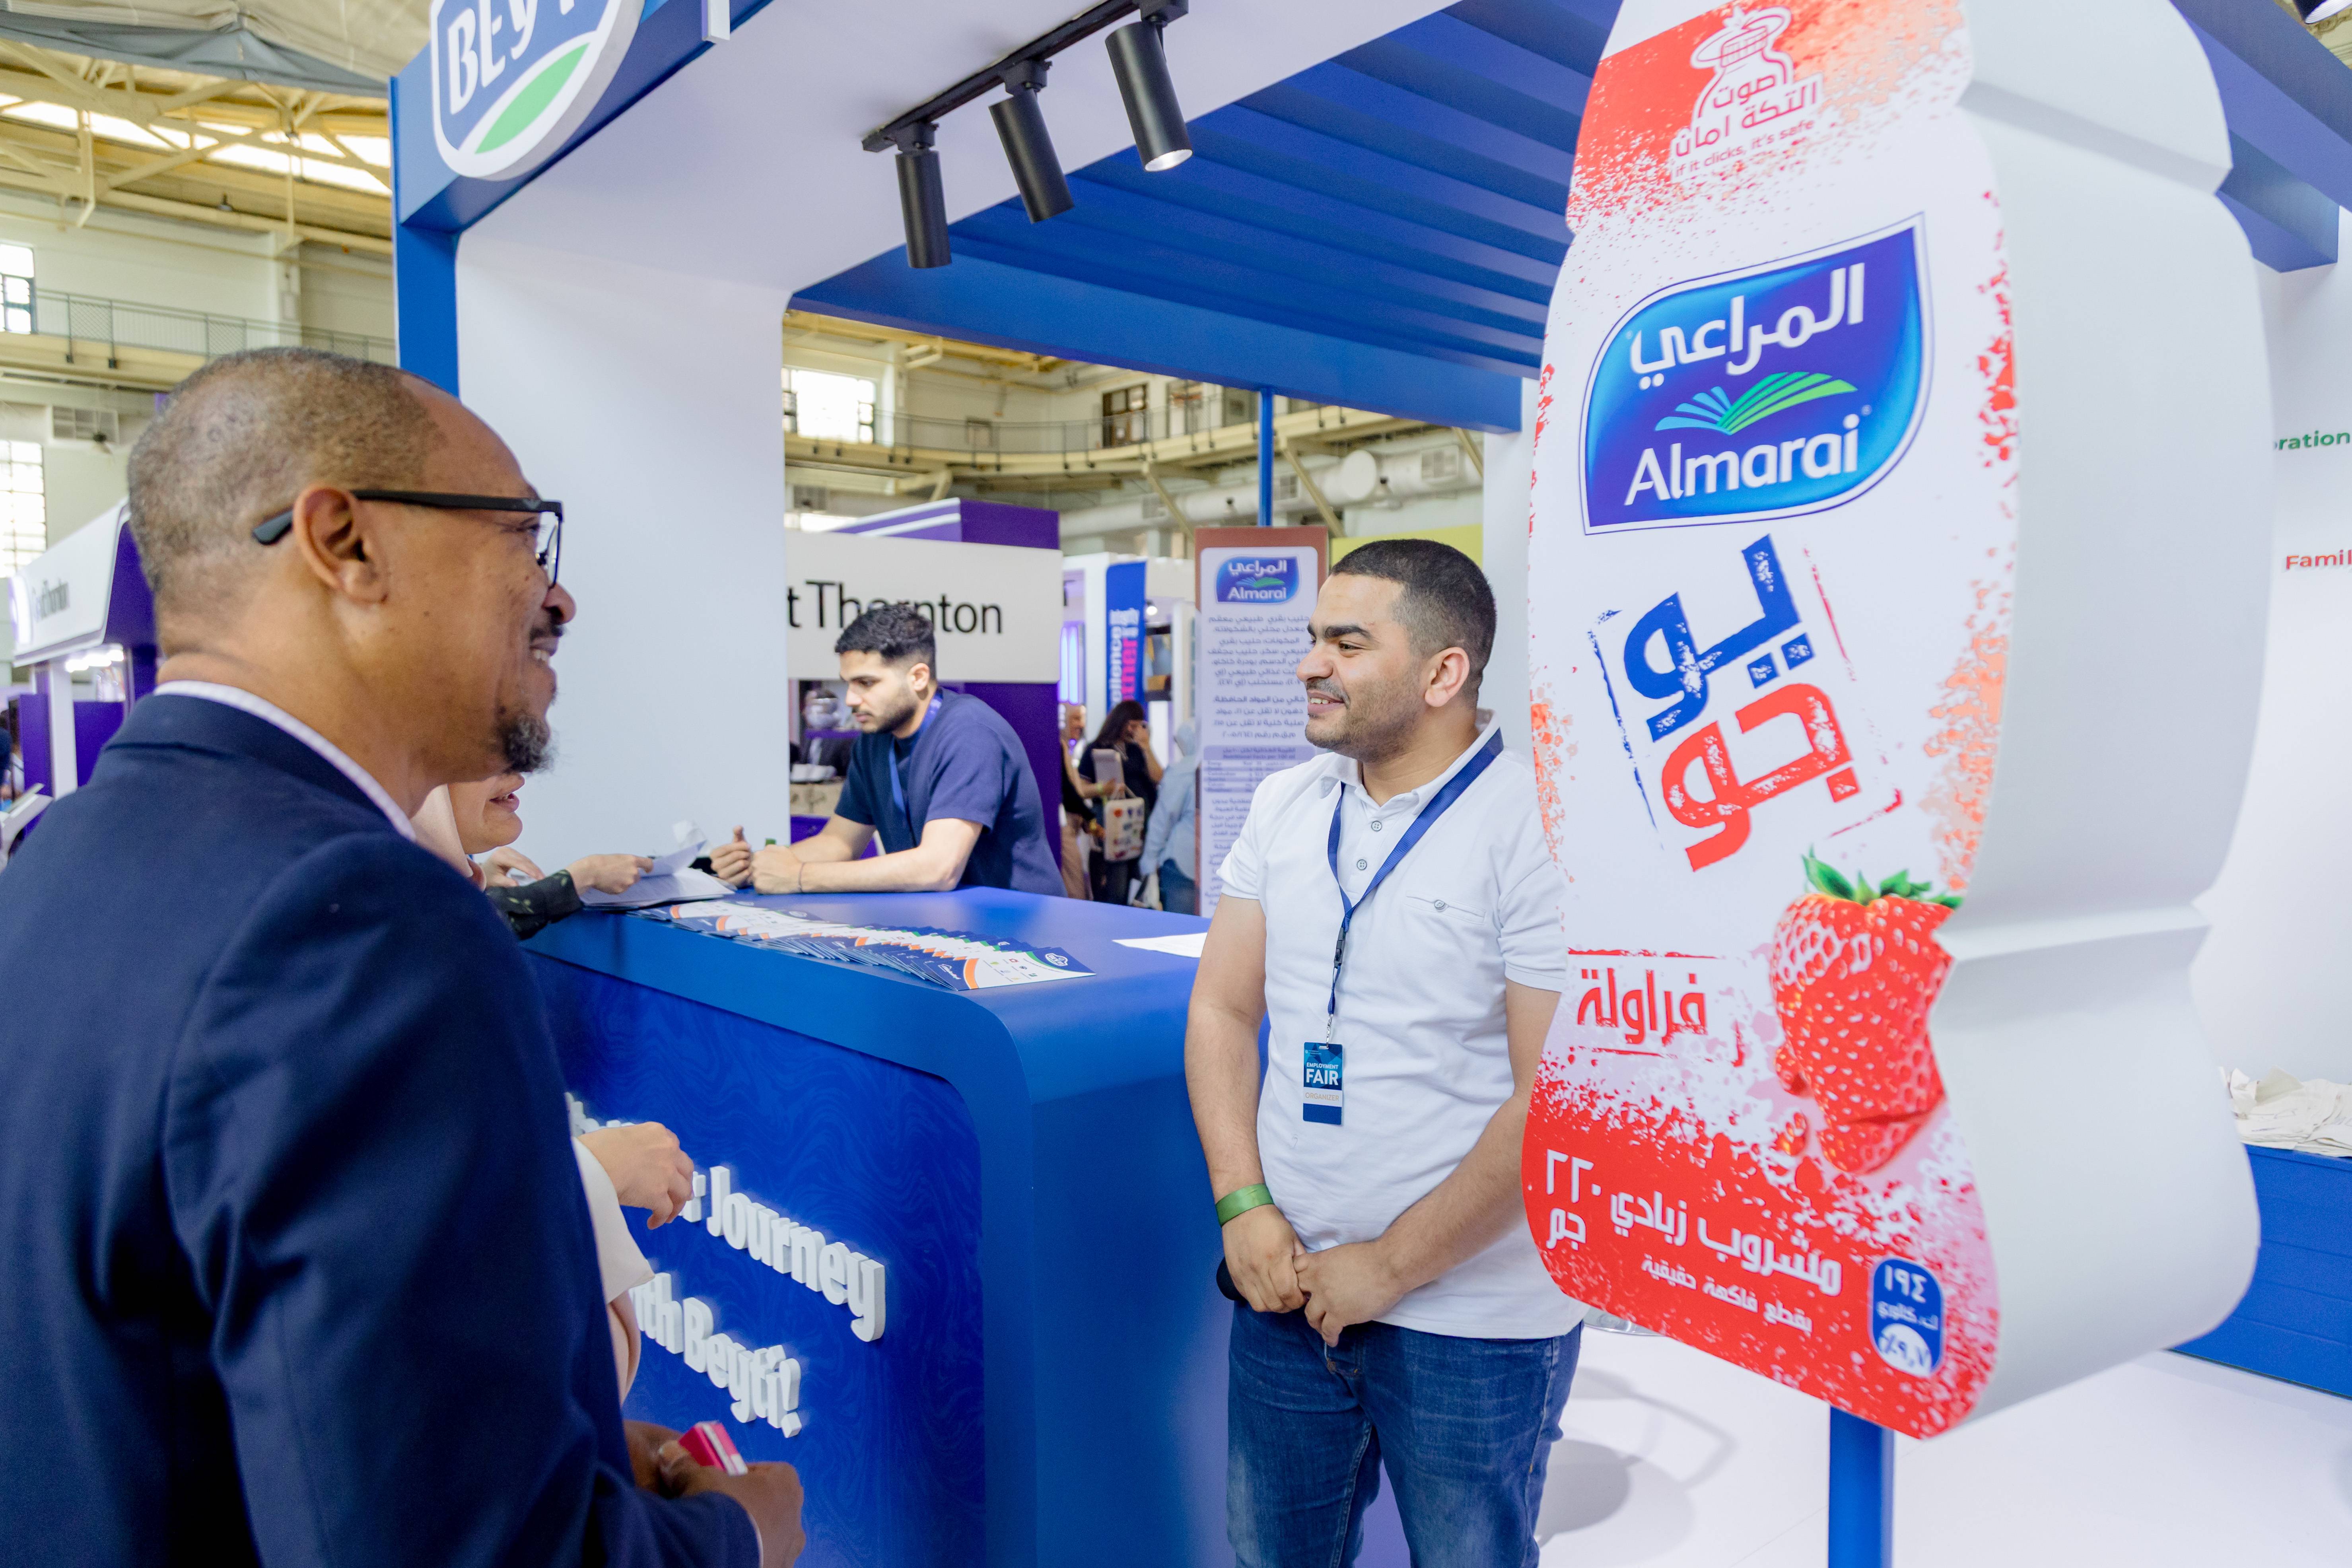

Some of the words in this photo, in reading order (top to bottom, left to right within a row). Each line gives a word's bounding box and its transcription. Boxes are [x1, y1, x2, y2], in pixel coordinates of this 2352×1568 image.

[1713, 74, 1776, 109] صوت
[1742, 81, 1816, 128] التكة
[1676, 163, 1686, 177] if
[1690, 160, 1701, 172] it
[1704, 145, 1746, 167] clicks,
[1752, 134, 1774, 148] it's
[1779, 120, 1814, 140] safe
[1629, 262, 1864, 390] المراعي
[1624, 413, 1860, 505] Almarai
[2274, 430, 2350, 450] ration
[1227, 587, 1287, 599] Almarai
[1228, 560, 1287, 577] المراعي
[806, 579, 1002, 633] Thnton
[1577, 968, 1709, 1045] فراولة
[1305, 1092, 1339, 1101] ORGANIZER
[1306, 1069, 1339, 1085] FAIR
[1610, 1190, 1688, 1245] زبادي
[706, 1165, 886, 1342] Journey
[1697, 1217, 1842, 1296] مشروب
[628, 1272, 684, 1354] ith
[682, 1297, 803, 1438] Beyti!
